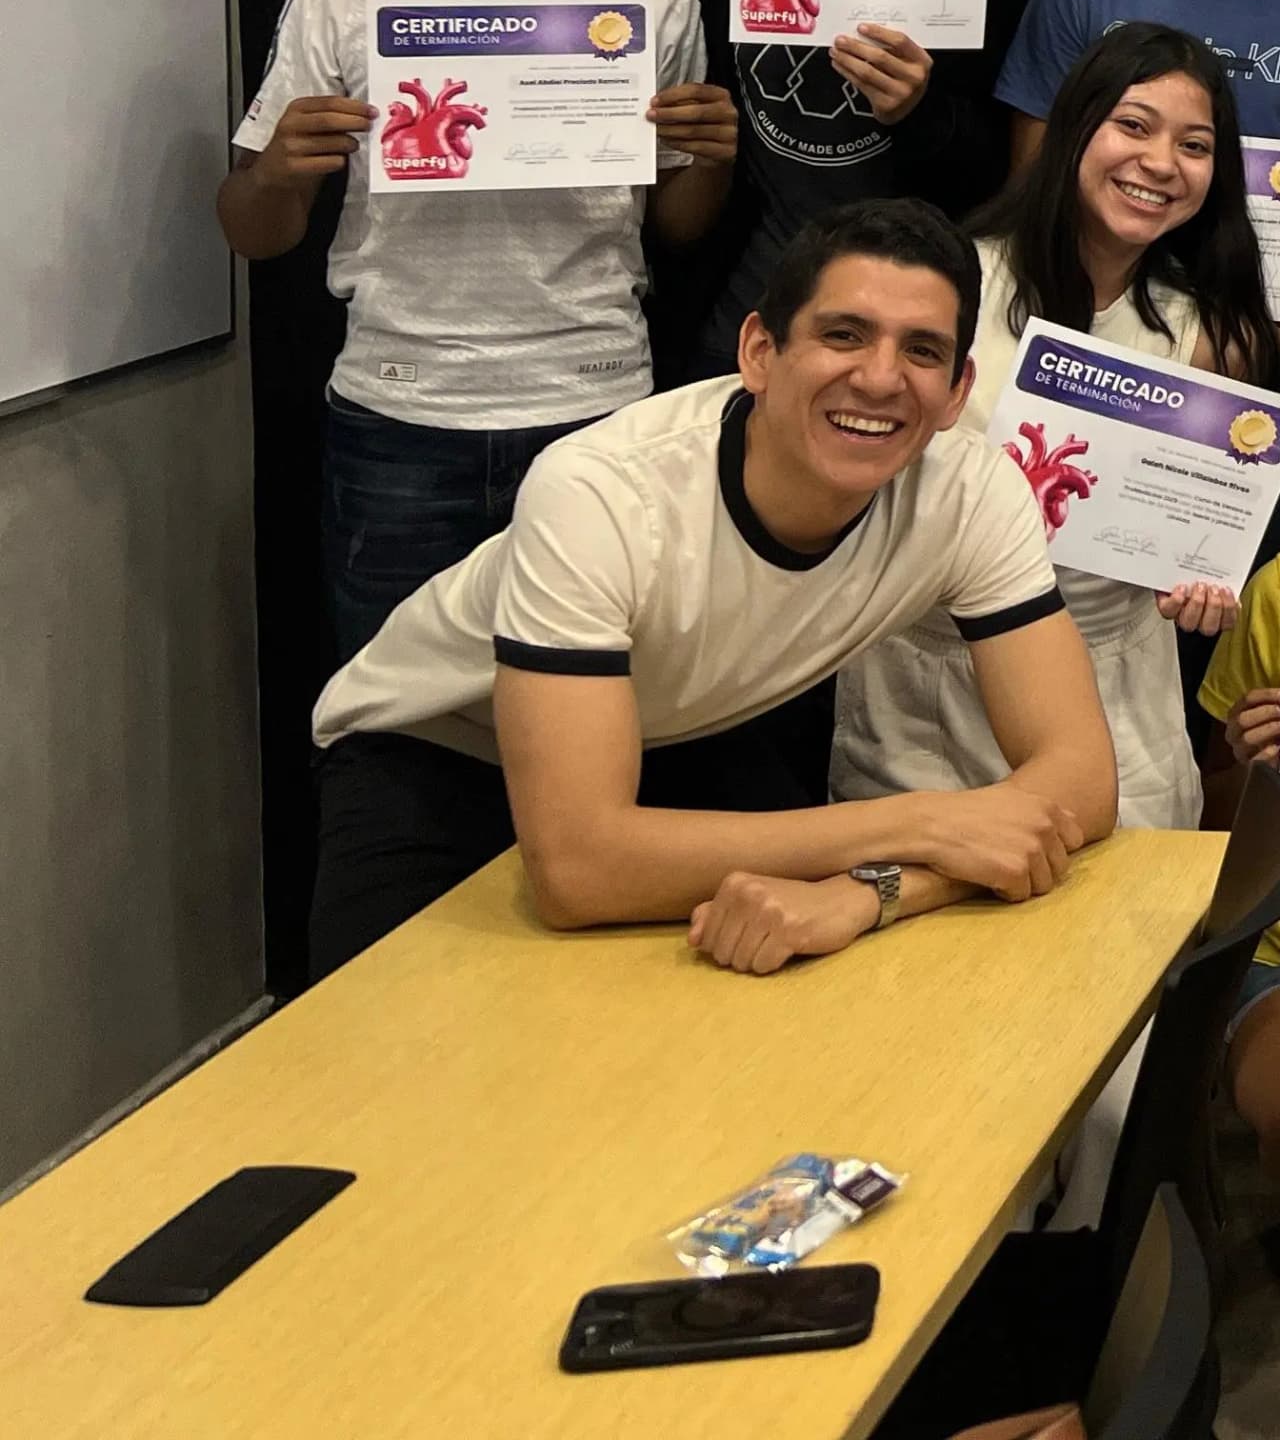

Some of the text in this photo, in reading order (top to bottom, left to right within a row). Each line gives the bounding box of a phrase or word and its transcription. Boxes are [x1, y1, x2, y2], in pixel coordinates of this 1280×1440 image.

[391, 17, 537, 34] CERTIFICADO
[742, 10, 797, 26] Superfy
[393, 34, 500, 46] DE TERMINACIÓN
[757, 110, 881, 155] QUALITY MADE GOODS
[383, 155, 447, 171] Superfy
[1039, 352, 1185, 409] CERTIFICADO
[1034, 371, 1142, 413] DE TERMINACIÓN
[1165, 463, 1189, 476] Nicole
